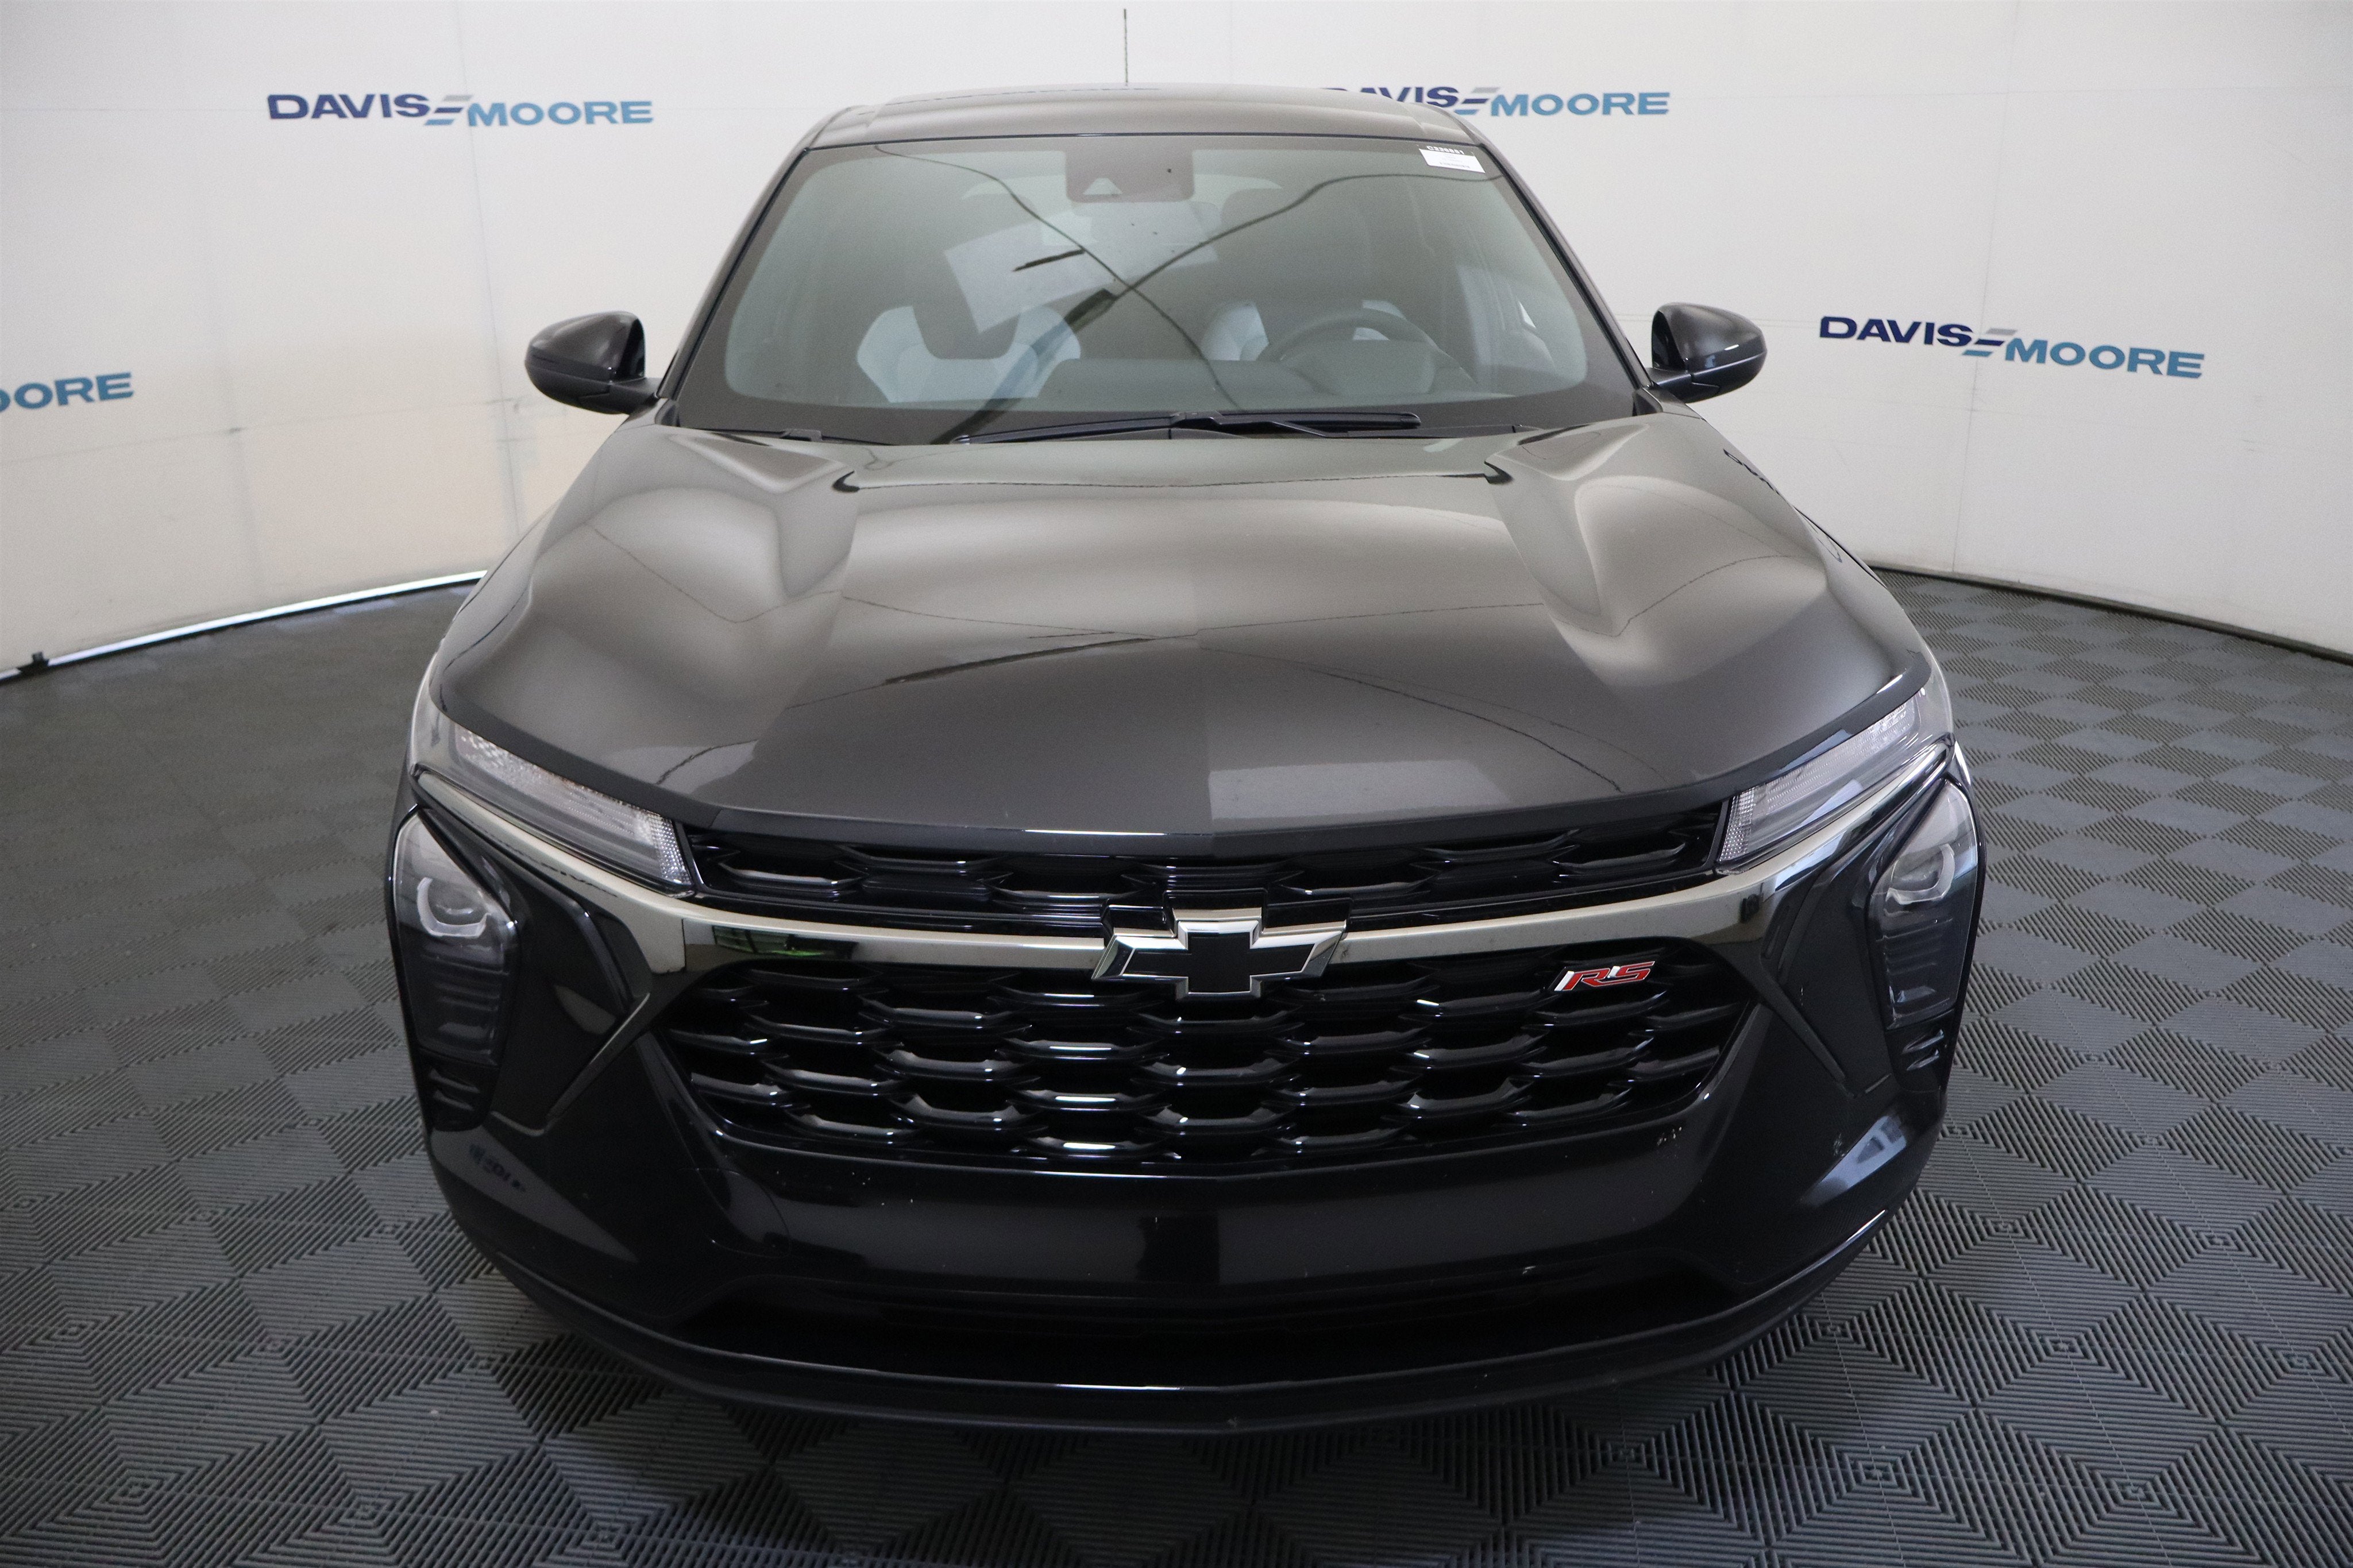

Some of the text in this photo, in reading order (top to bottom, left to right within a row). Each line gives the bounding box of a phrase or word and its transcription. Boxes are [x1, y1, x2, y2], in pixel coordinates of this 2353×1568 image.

[268, 94, 654, 127] DAVIS MOORE
[1322, 86, 1671, 116] VIS MOORE
[1819, 316, 2205, 379] DAVIS MOORE
[0, 372, 134, 413] ORE
[1554, 960, 1656, 991] RS
